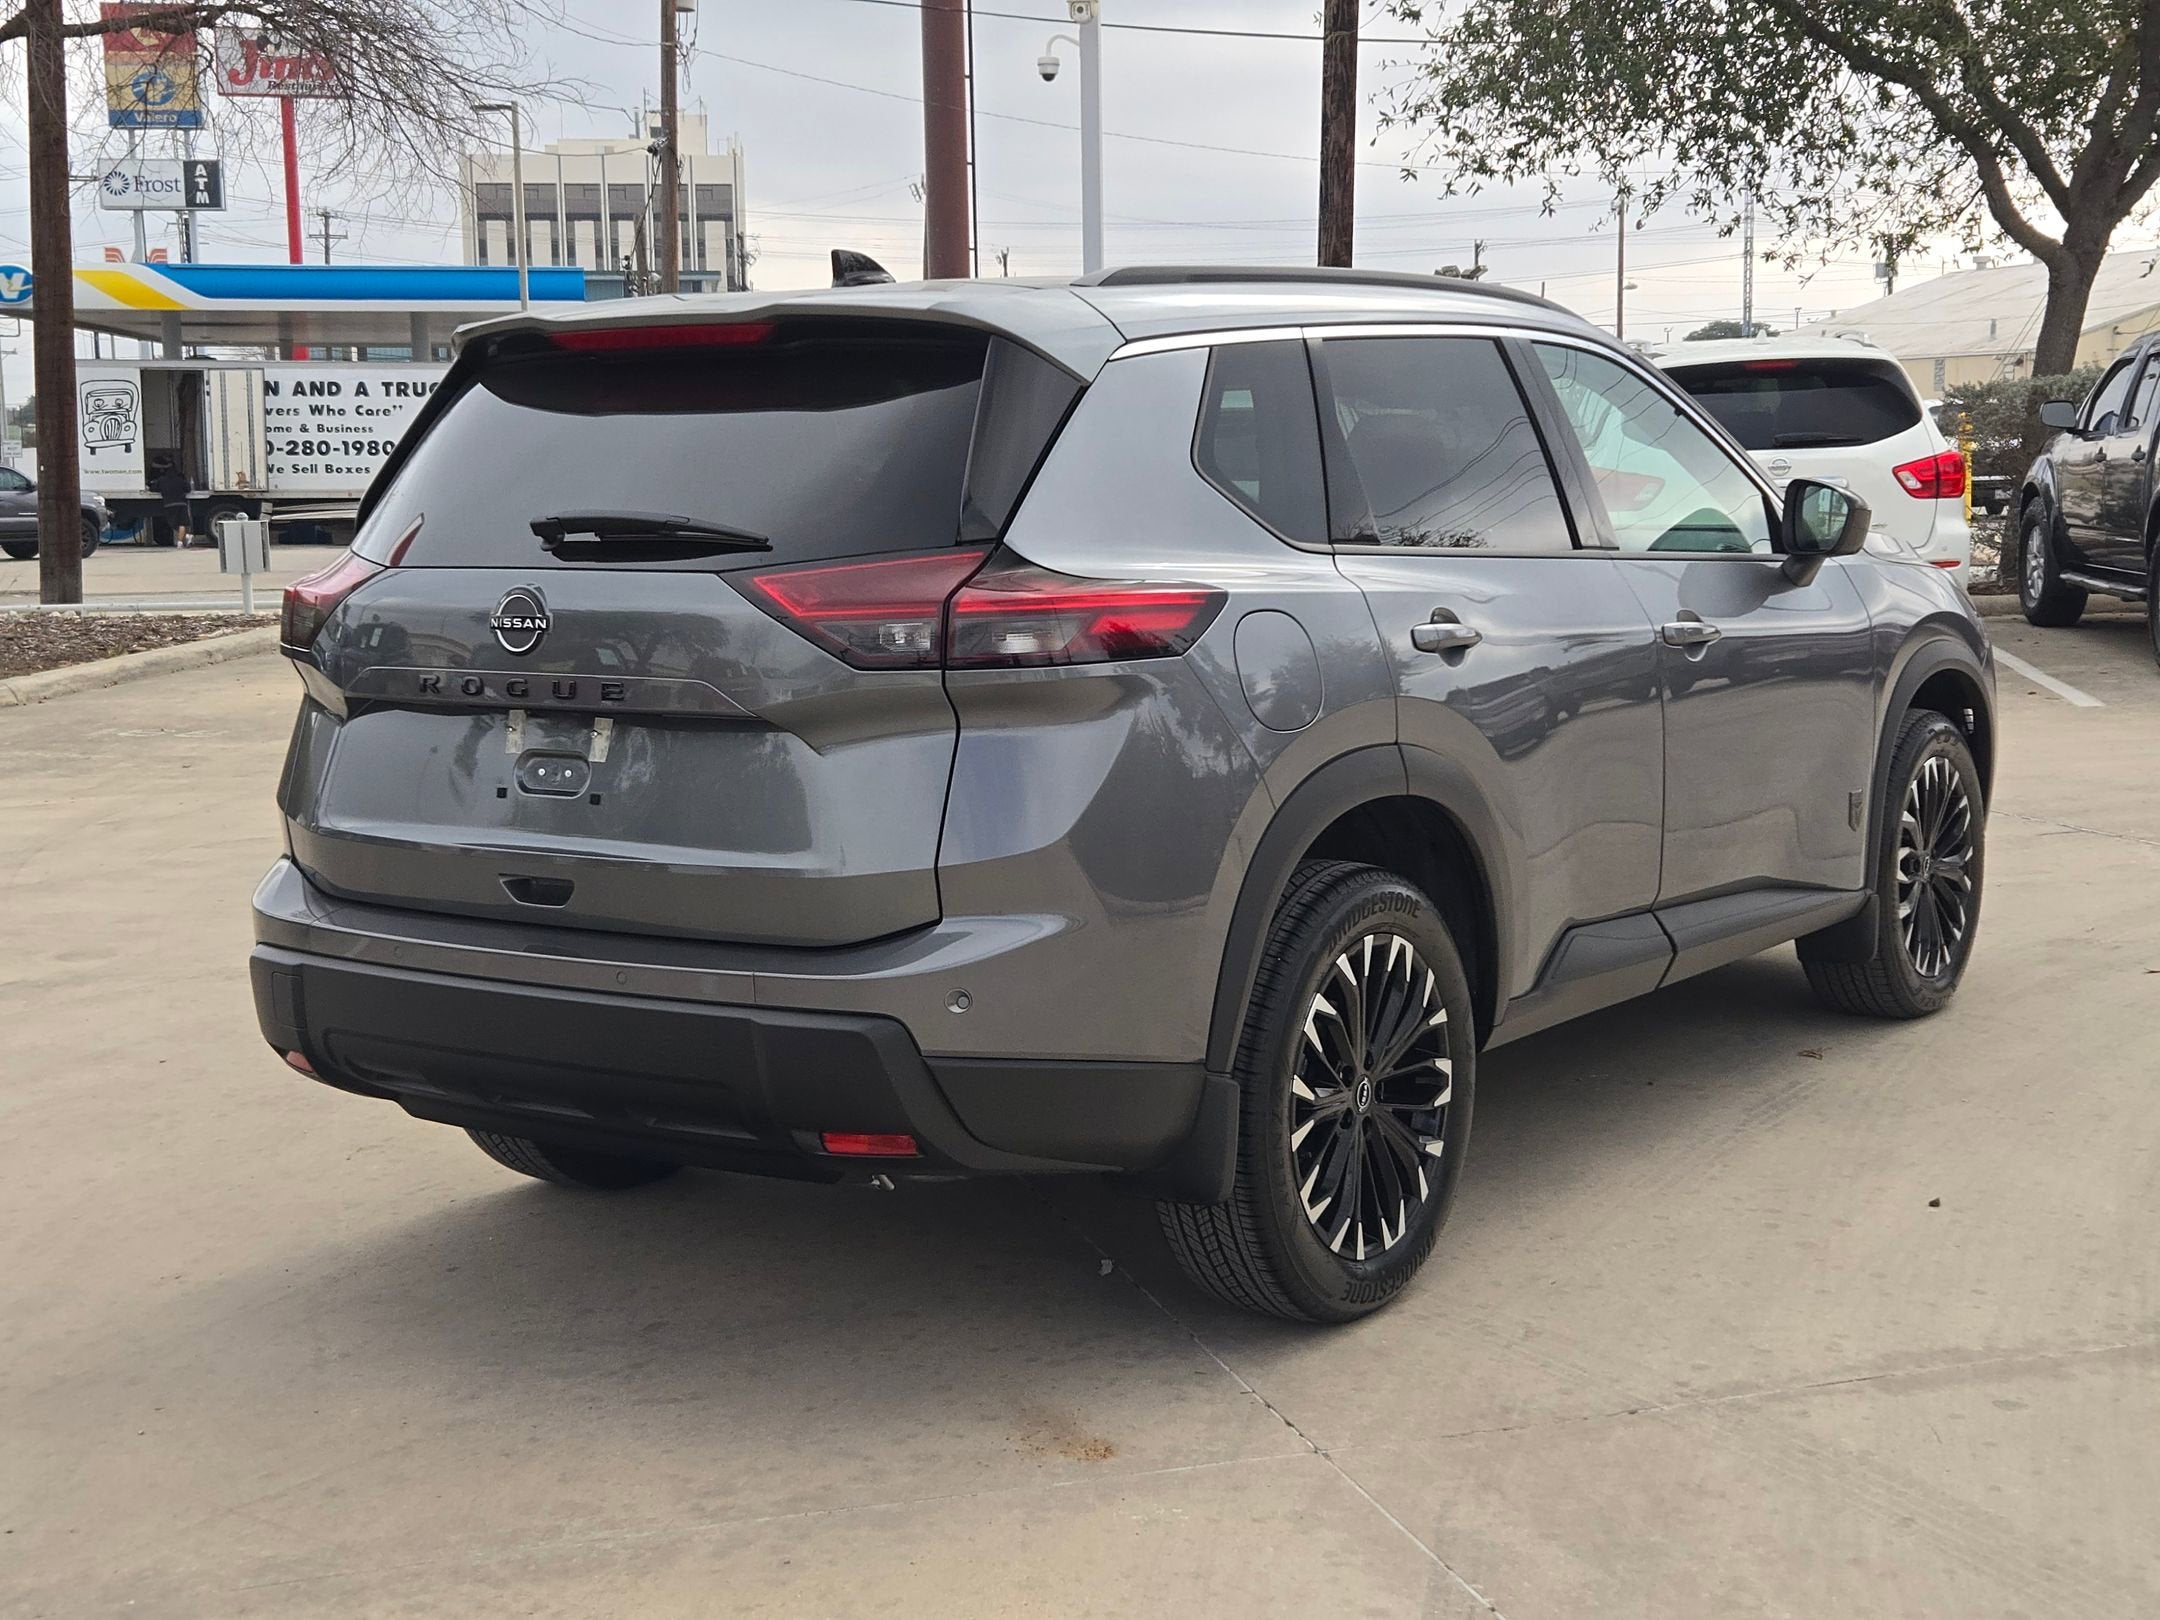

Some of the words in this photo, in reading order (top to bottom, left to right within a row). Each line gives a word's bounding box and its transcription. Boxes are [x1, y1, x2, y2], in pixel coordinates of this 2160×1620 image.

[133, 175, 182, 192] Frost
[194, 163, 210, 204] ATM
[292, 380, 342, 397] AND
[354, 381, 370, 397] A
[308, 404, 346, 416] Who
[299, 423, 310, 433] &
[317, 423, 374, 433] Business
[291, 463, 319, 474] Sell
[325, 463, 371, 474] Boxes
[490, 617, 547, 629] NISSAN
[419, 673, 625, 700] ROGUE
